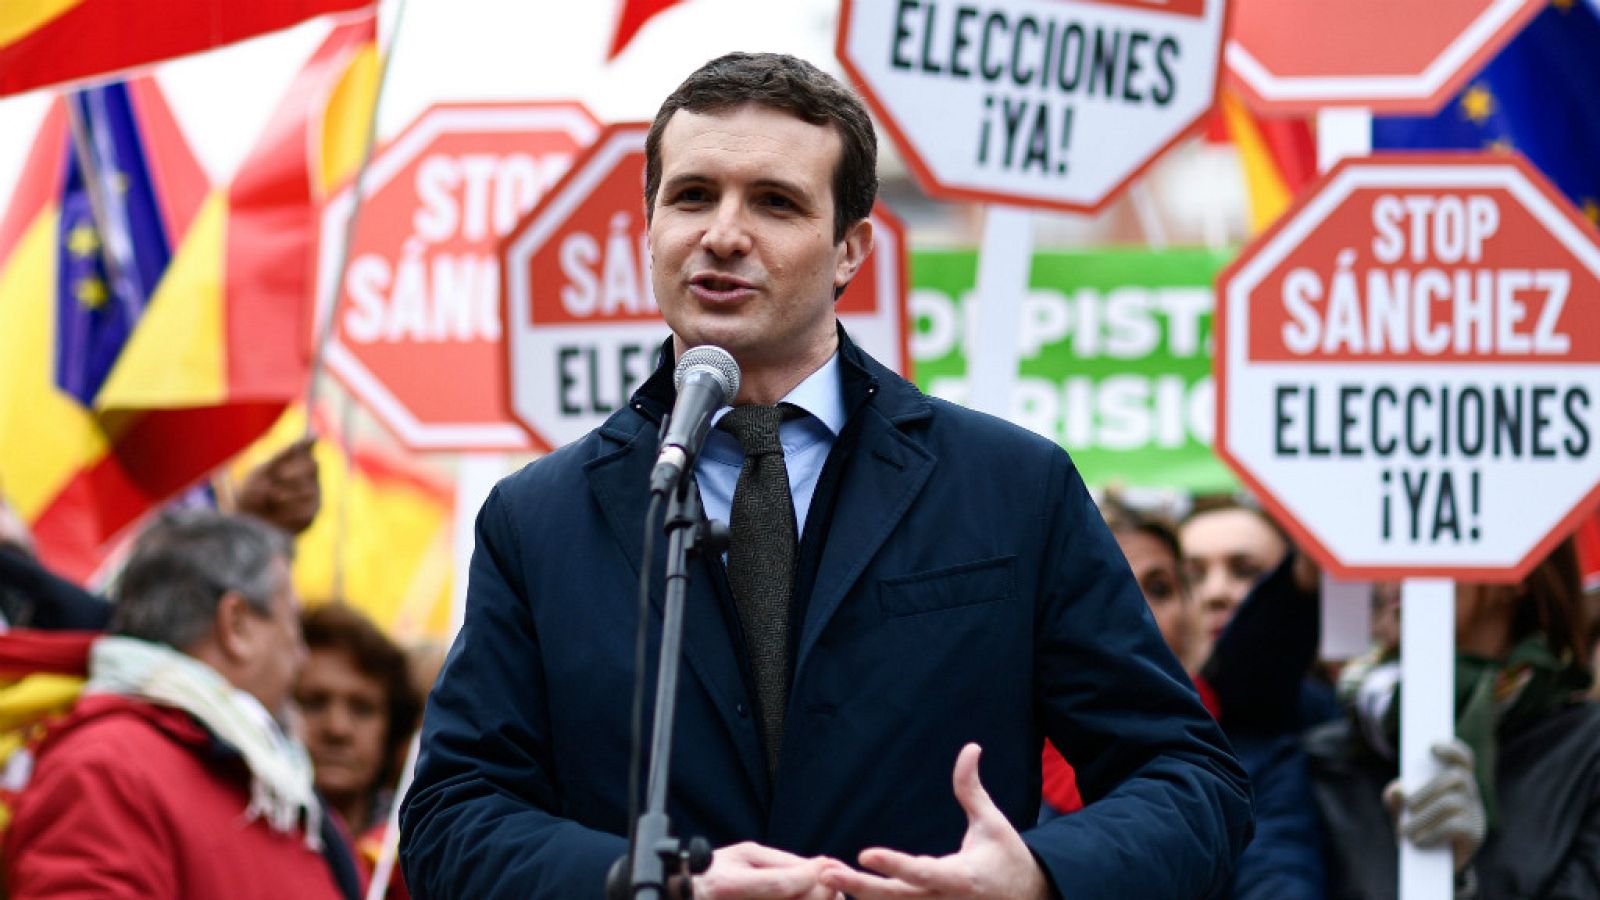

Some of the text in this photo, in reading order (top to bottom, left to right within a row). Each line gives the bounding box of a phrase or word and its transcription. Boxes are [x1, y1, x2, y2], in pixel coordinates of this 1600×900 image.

[891, 0, 1181, 107] ELECCIONES
[976, 97, 1075, 175] ¡YA!
[1371, 194, 1499, 263] STOP
[1281, 248, 1571, 355] SÁNCHEZ
[558, 345, 664, 416] ELE
[1274, 384, 1591, 458] ELECCIONES
[1379, 469, 1481, 542] ¡YA!
